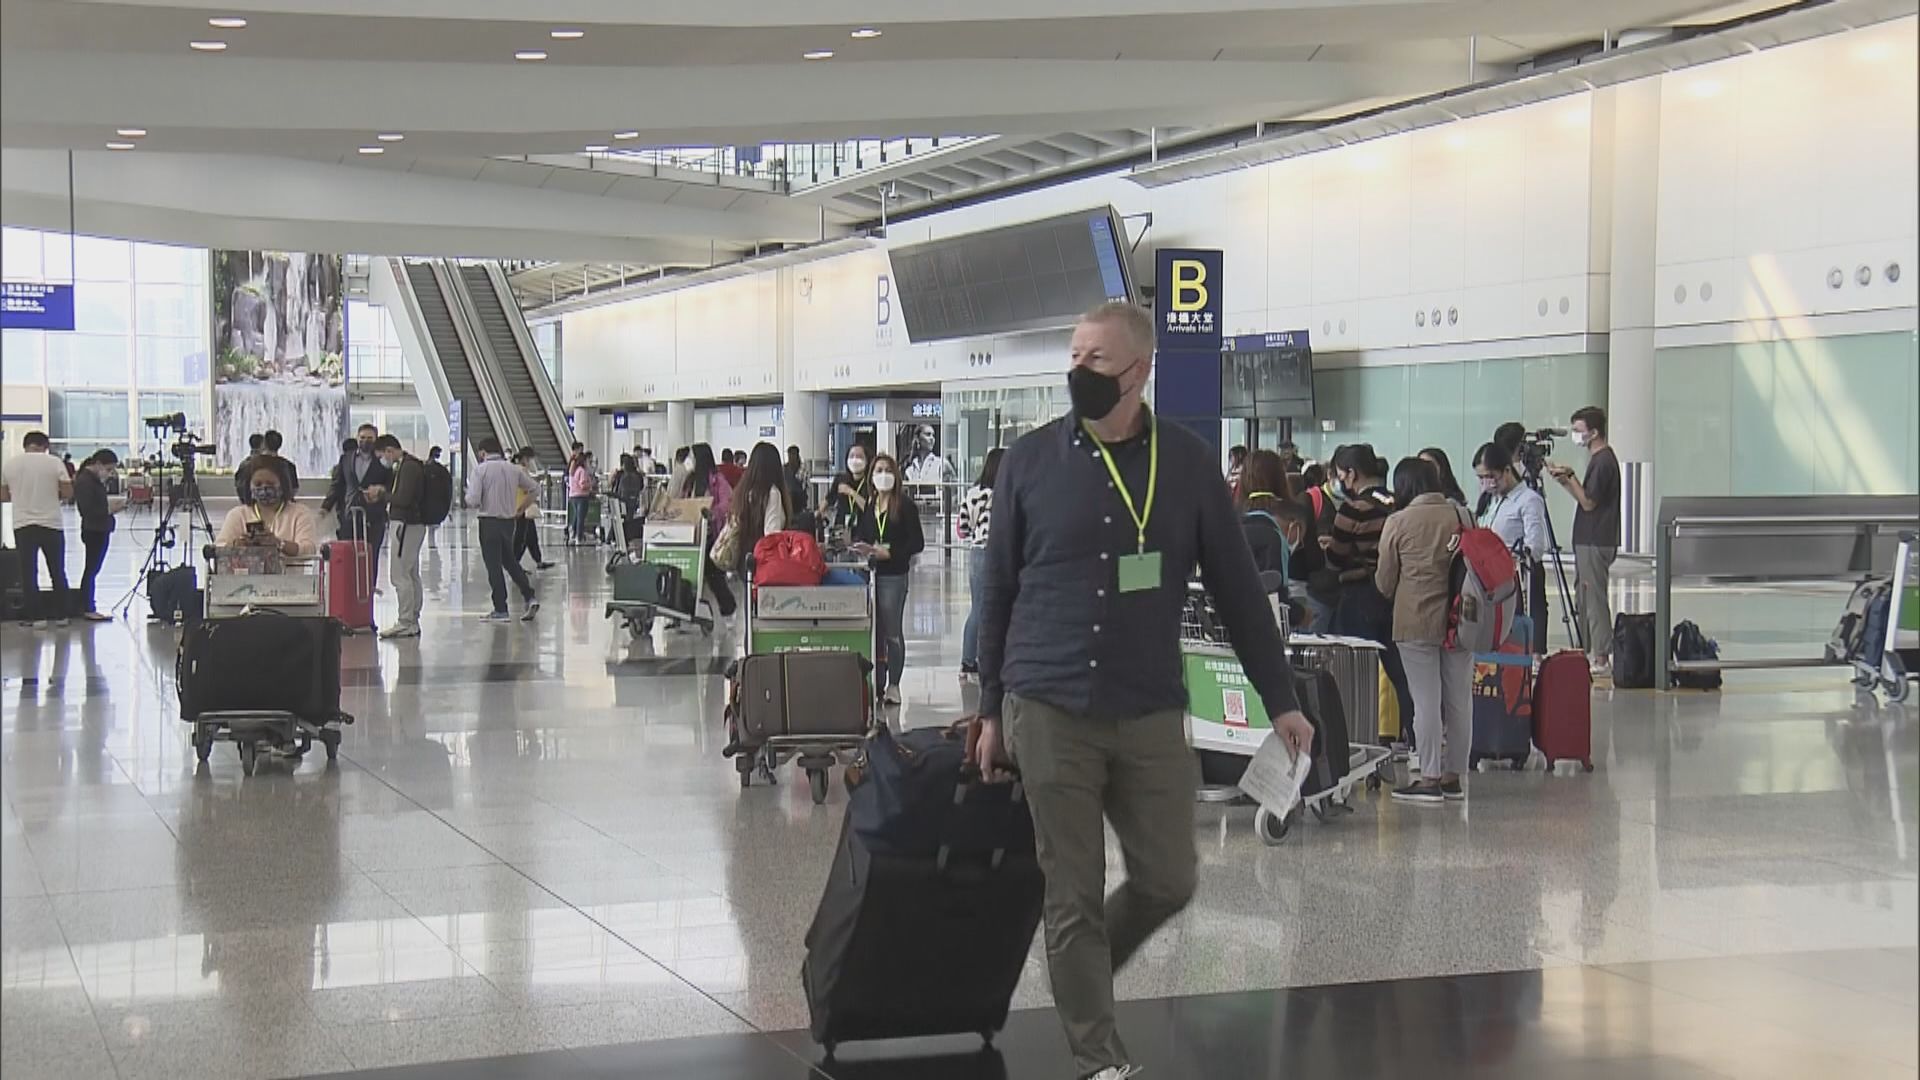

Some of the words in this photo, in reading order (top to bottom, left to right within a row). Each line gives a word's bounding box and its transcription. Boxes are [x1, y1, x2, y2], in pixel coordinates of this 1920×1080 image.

[878, 275, 890, 326] B
[1172, 260, 1207, 311] B
[1166, 312, 1214, 324] 接機大堂
[1167, 324, 1197, 333] Arrivals
[1199, 324, 1214, 333] Hall
